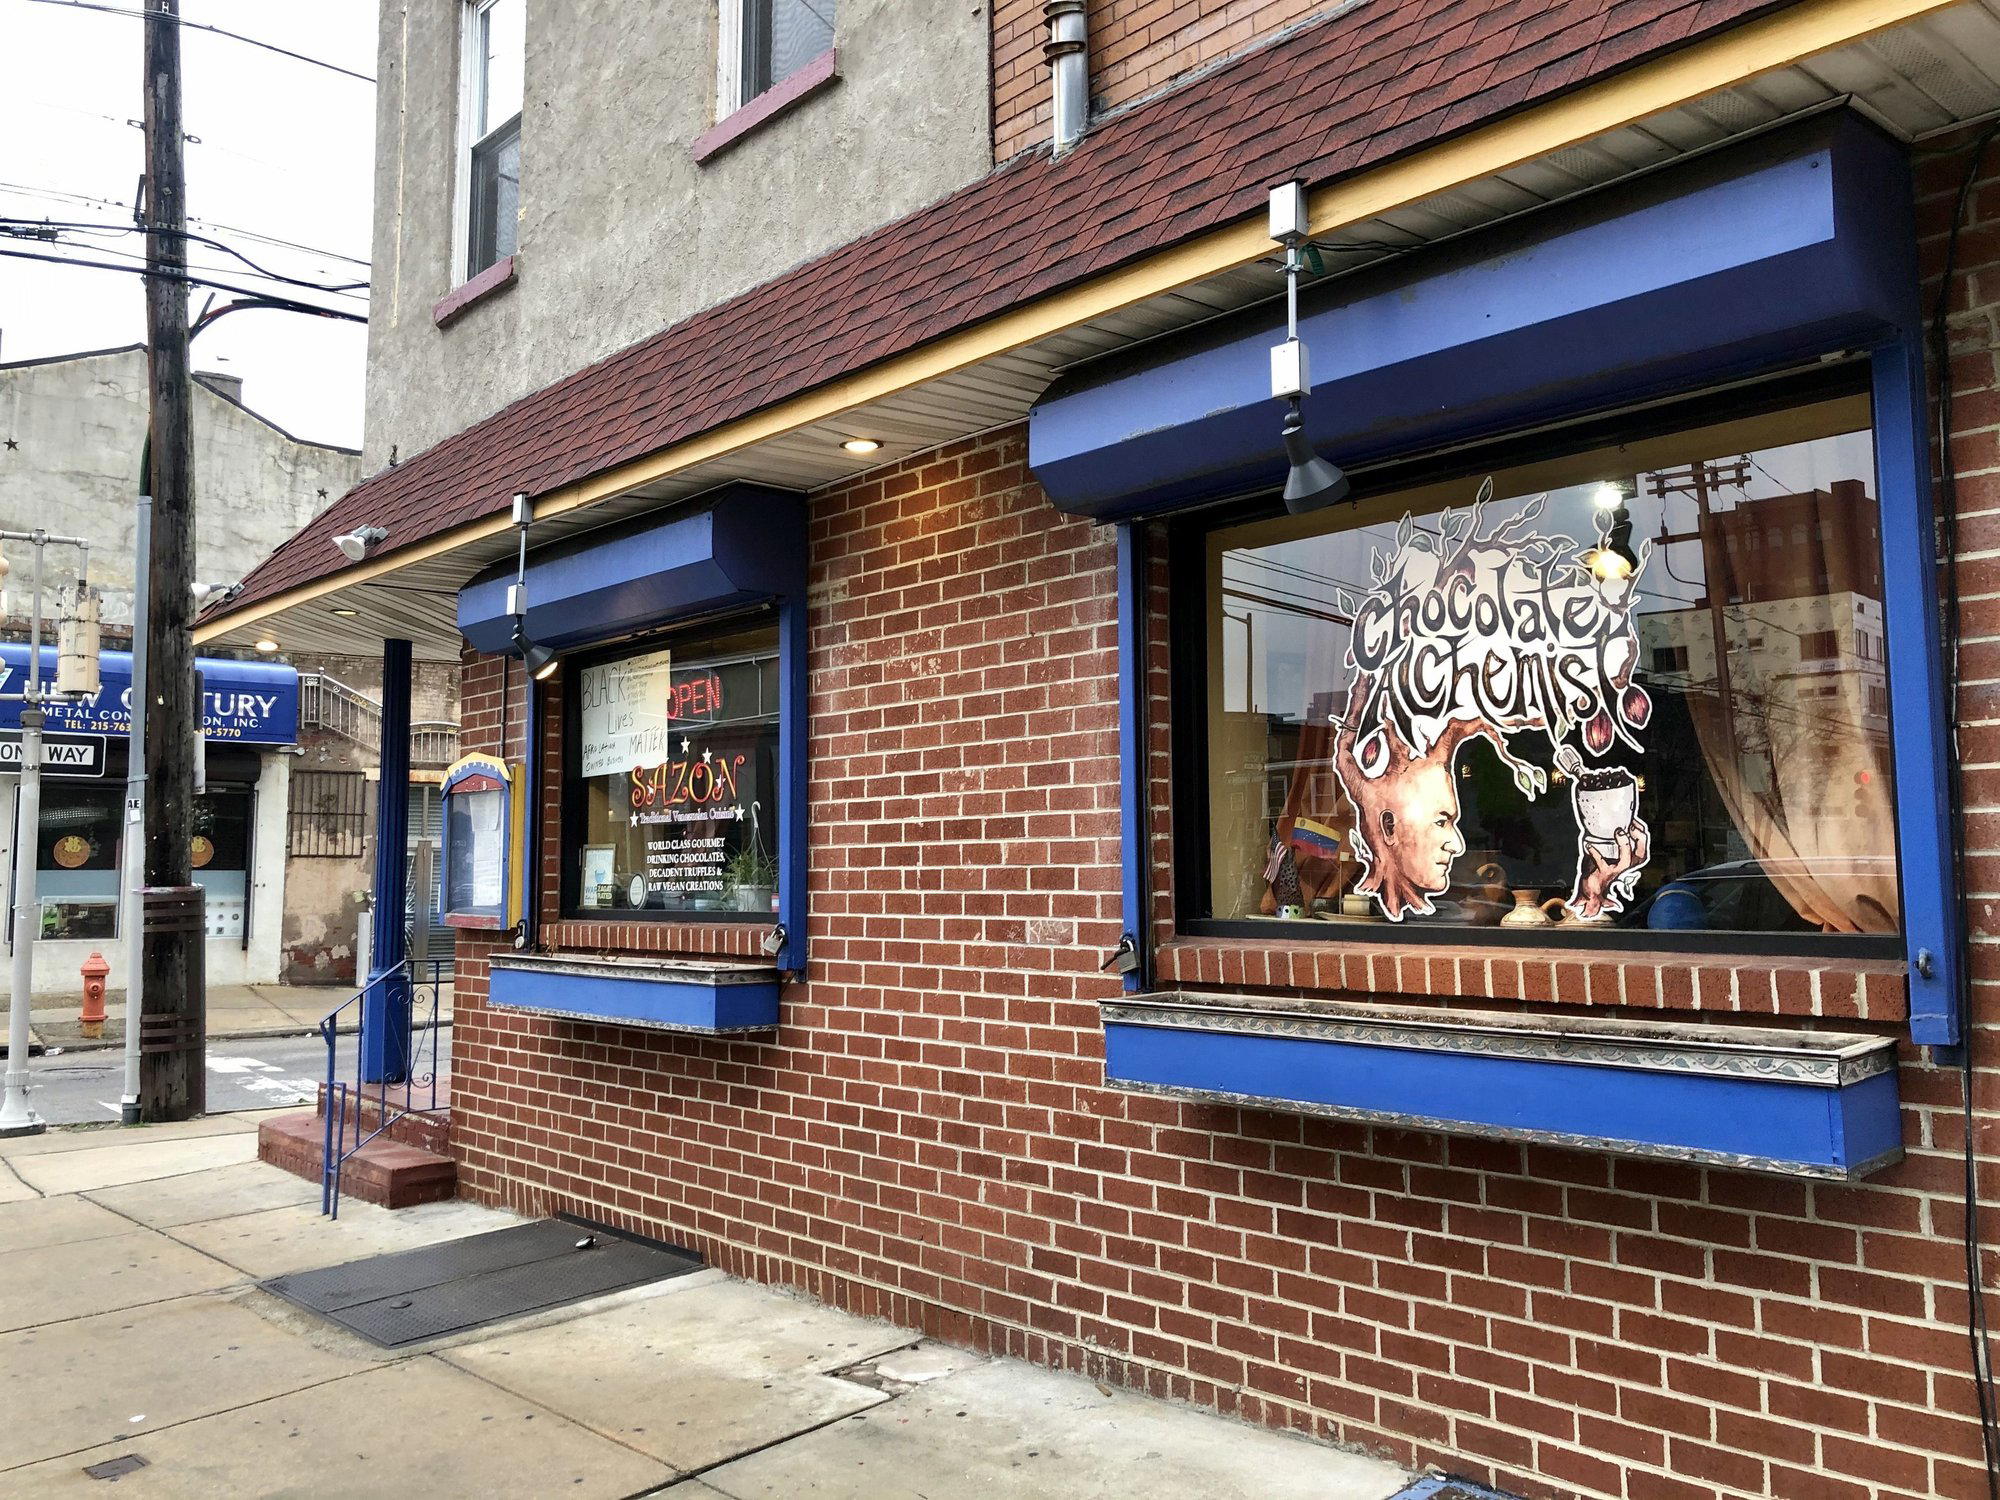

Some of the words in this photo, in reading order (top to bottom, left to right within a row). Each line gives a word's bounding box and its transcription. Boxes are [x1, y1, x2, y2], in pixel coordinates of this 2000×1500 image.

[582, 666, 627, 712] BLACK
[667, 675, 720, 720] OPEN
[41, 706, 93, 719] METAL
[64, 719, 86, 730] TEL:
[233, 717, 262, 728] INC.
[0, 744, 23, 760] ON
[48, 746, 88, 762] WAY
[647, 841, 670, 850] WORLD
[671, 840, 691, 850] CLASS
[692, 837, 725, 849] GOURMET
[646, 854, 679, 864] DRINKING
[649, 867, 684, 878] DECADENT
[684, 866, 716, 877] TRUFFLES
[648, 881, 662, 891] RAW
[662, 881, 685, 891] VEGAN
[685, 880, 724, 891] CREATIONS
